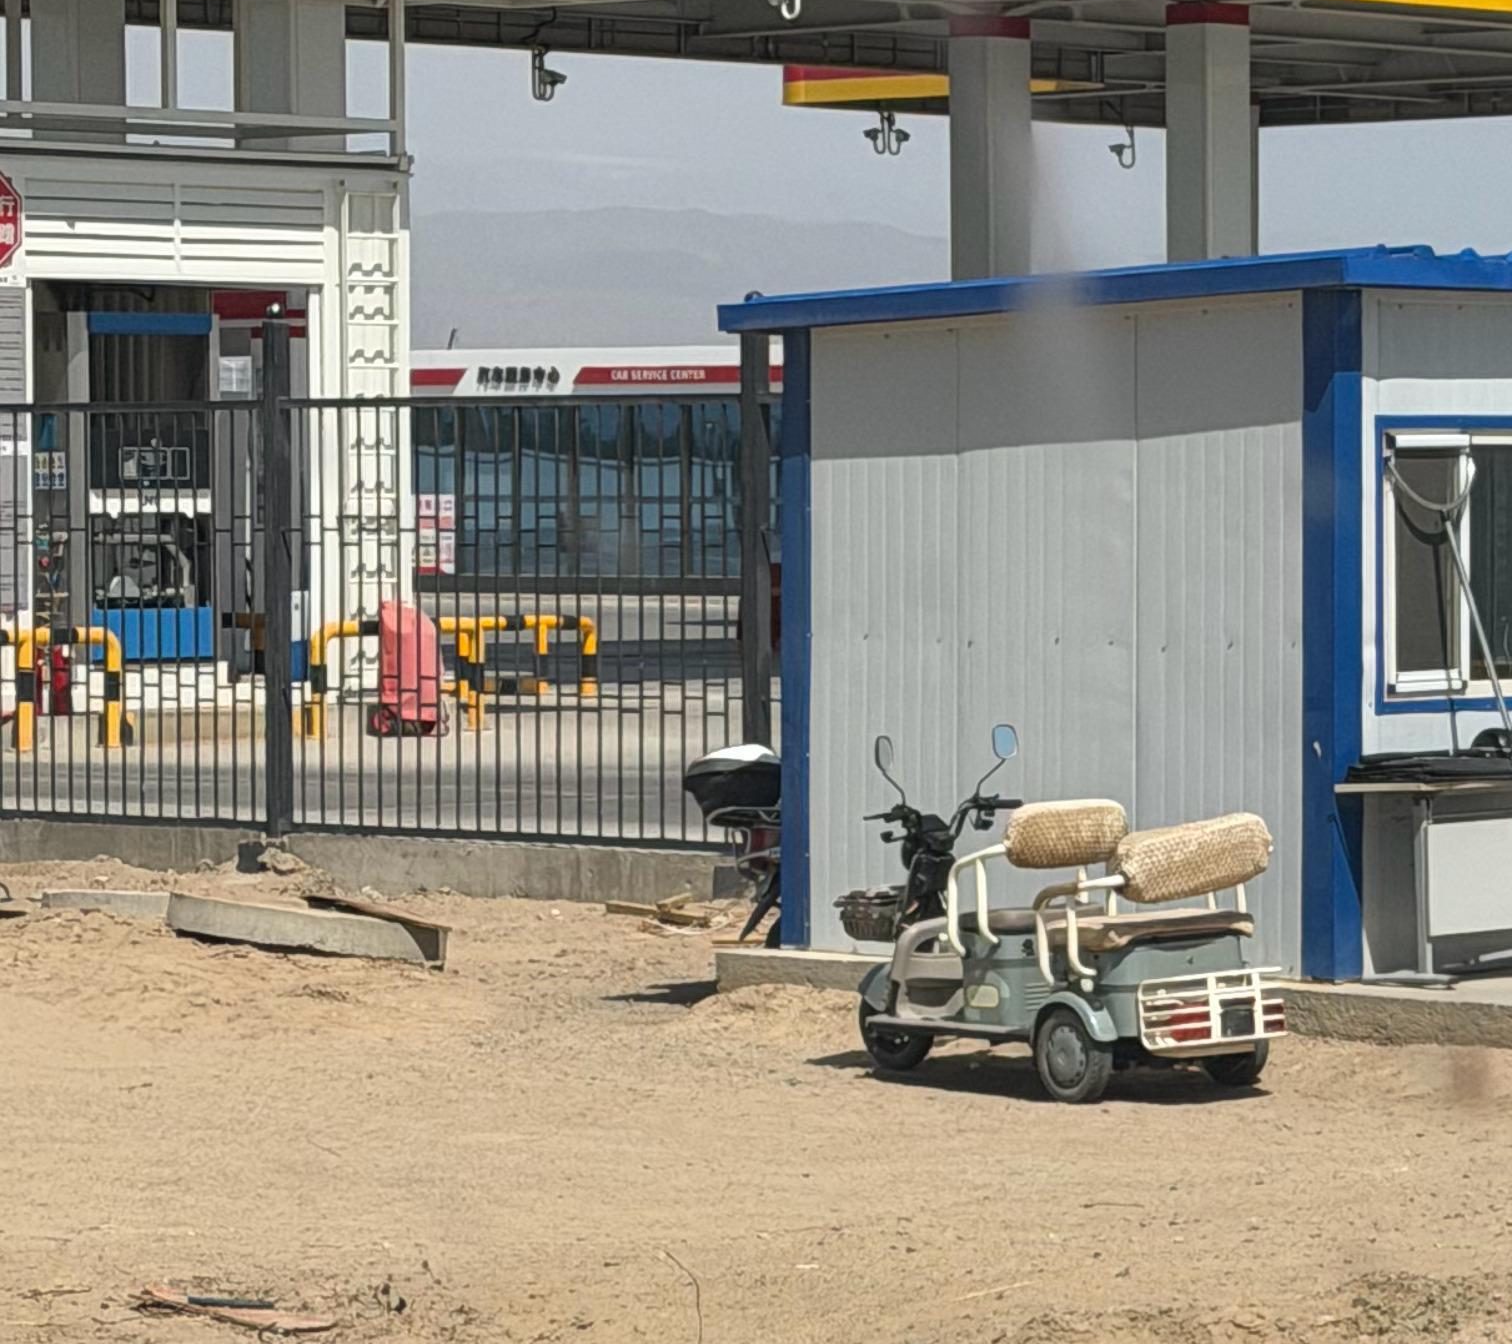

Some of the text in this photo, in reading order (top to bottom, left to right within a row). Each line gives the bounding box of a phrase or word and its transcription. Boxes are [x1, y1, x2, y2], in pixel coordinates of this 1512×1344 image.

[611, 368, 706, 381] CAR SERVICE CENTER
